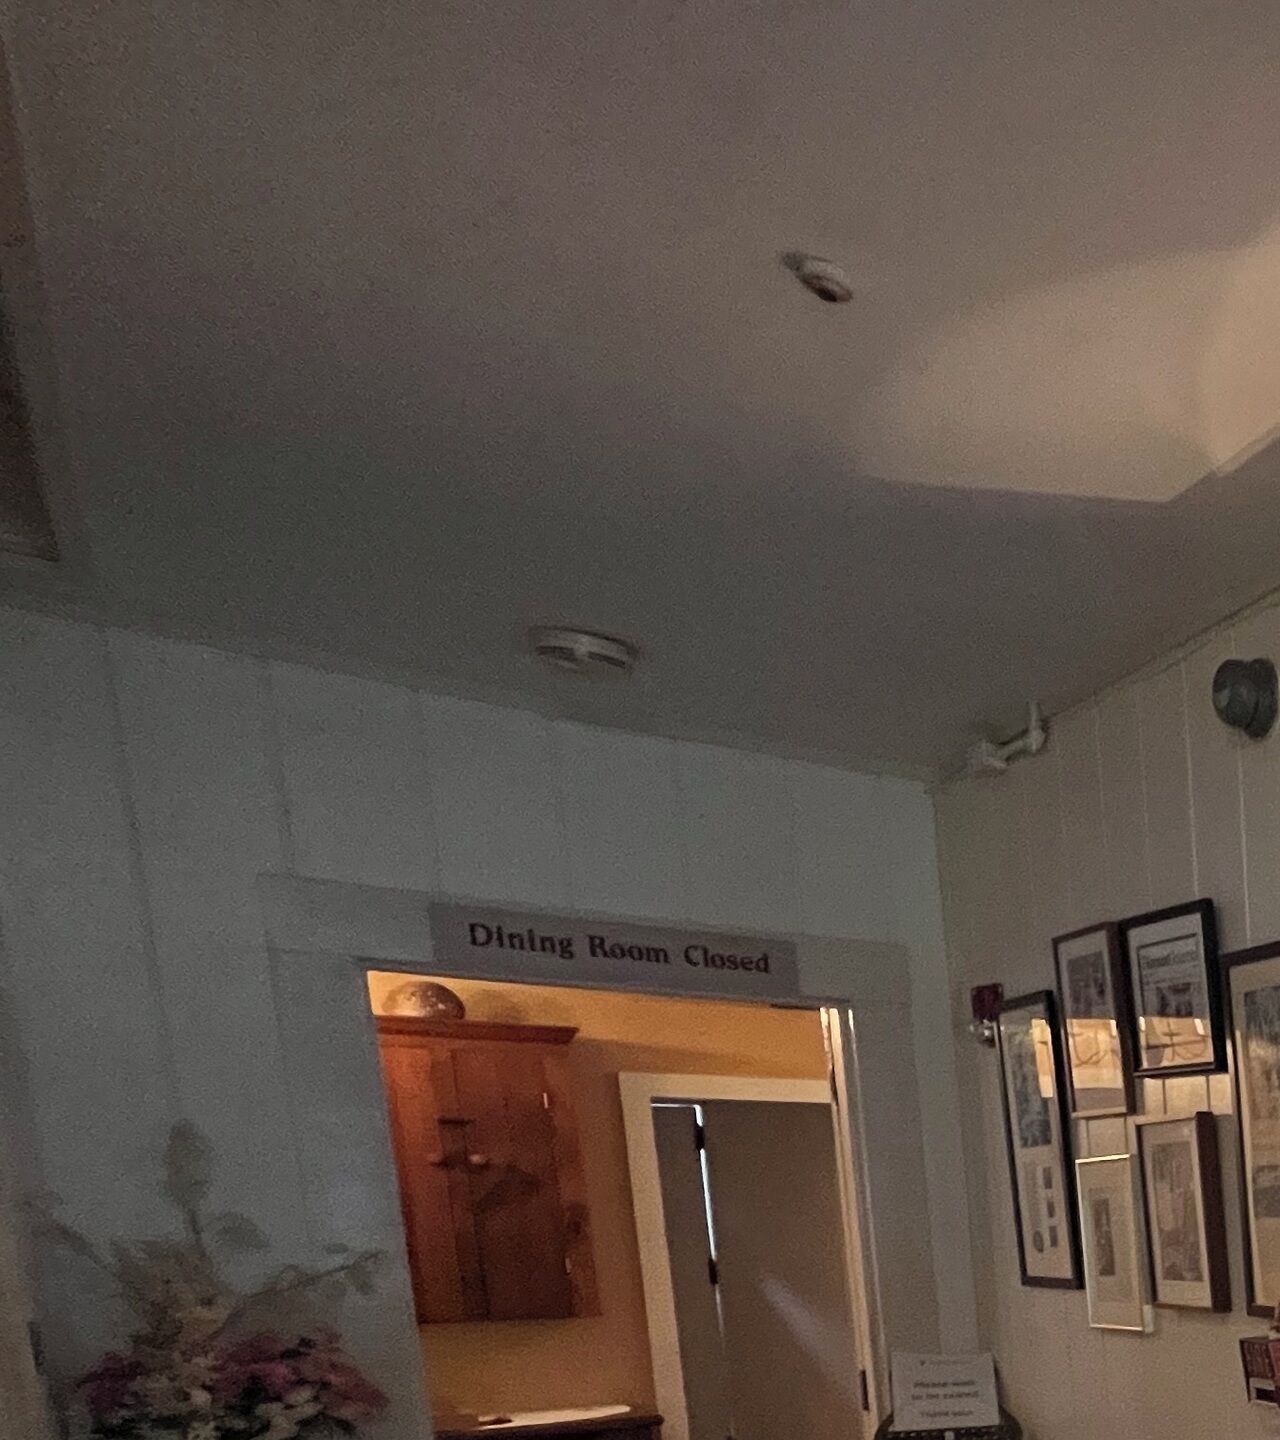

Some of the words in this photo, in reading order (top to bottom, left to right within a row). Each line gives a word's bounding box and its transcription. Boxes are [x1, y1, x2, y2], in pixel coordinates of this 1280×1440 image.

[468, 922, 574, 960] Dining
[589, 935, 670, 964] Room
[684, 945, 771, 974] Closed
